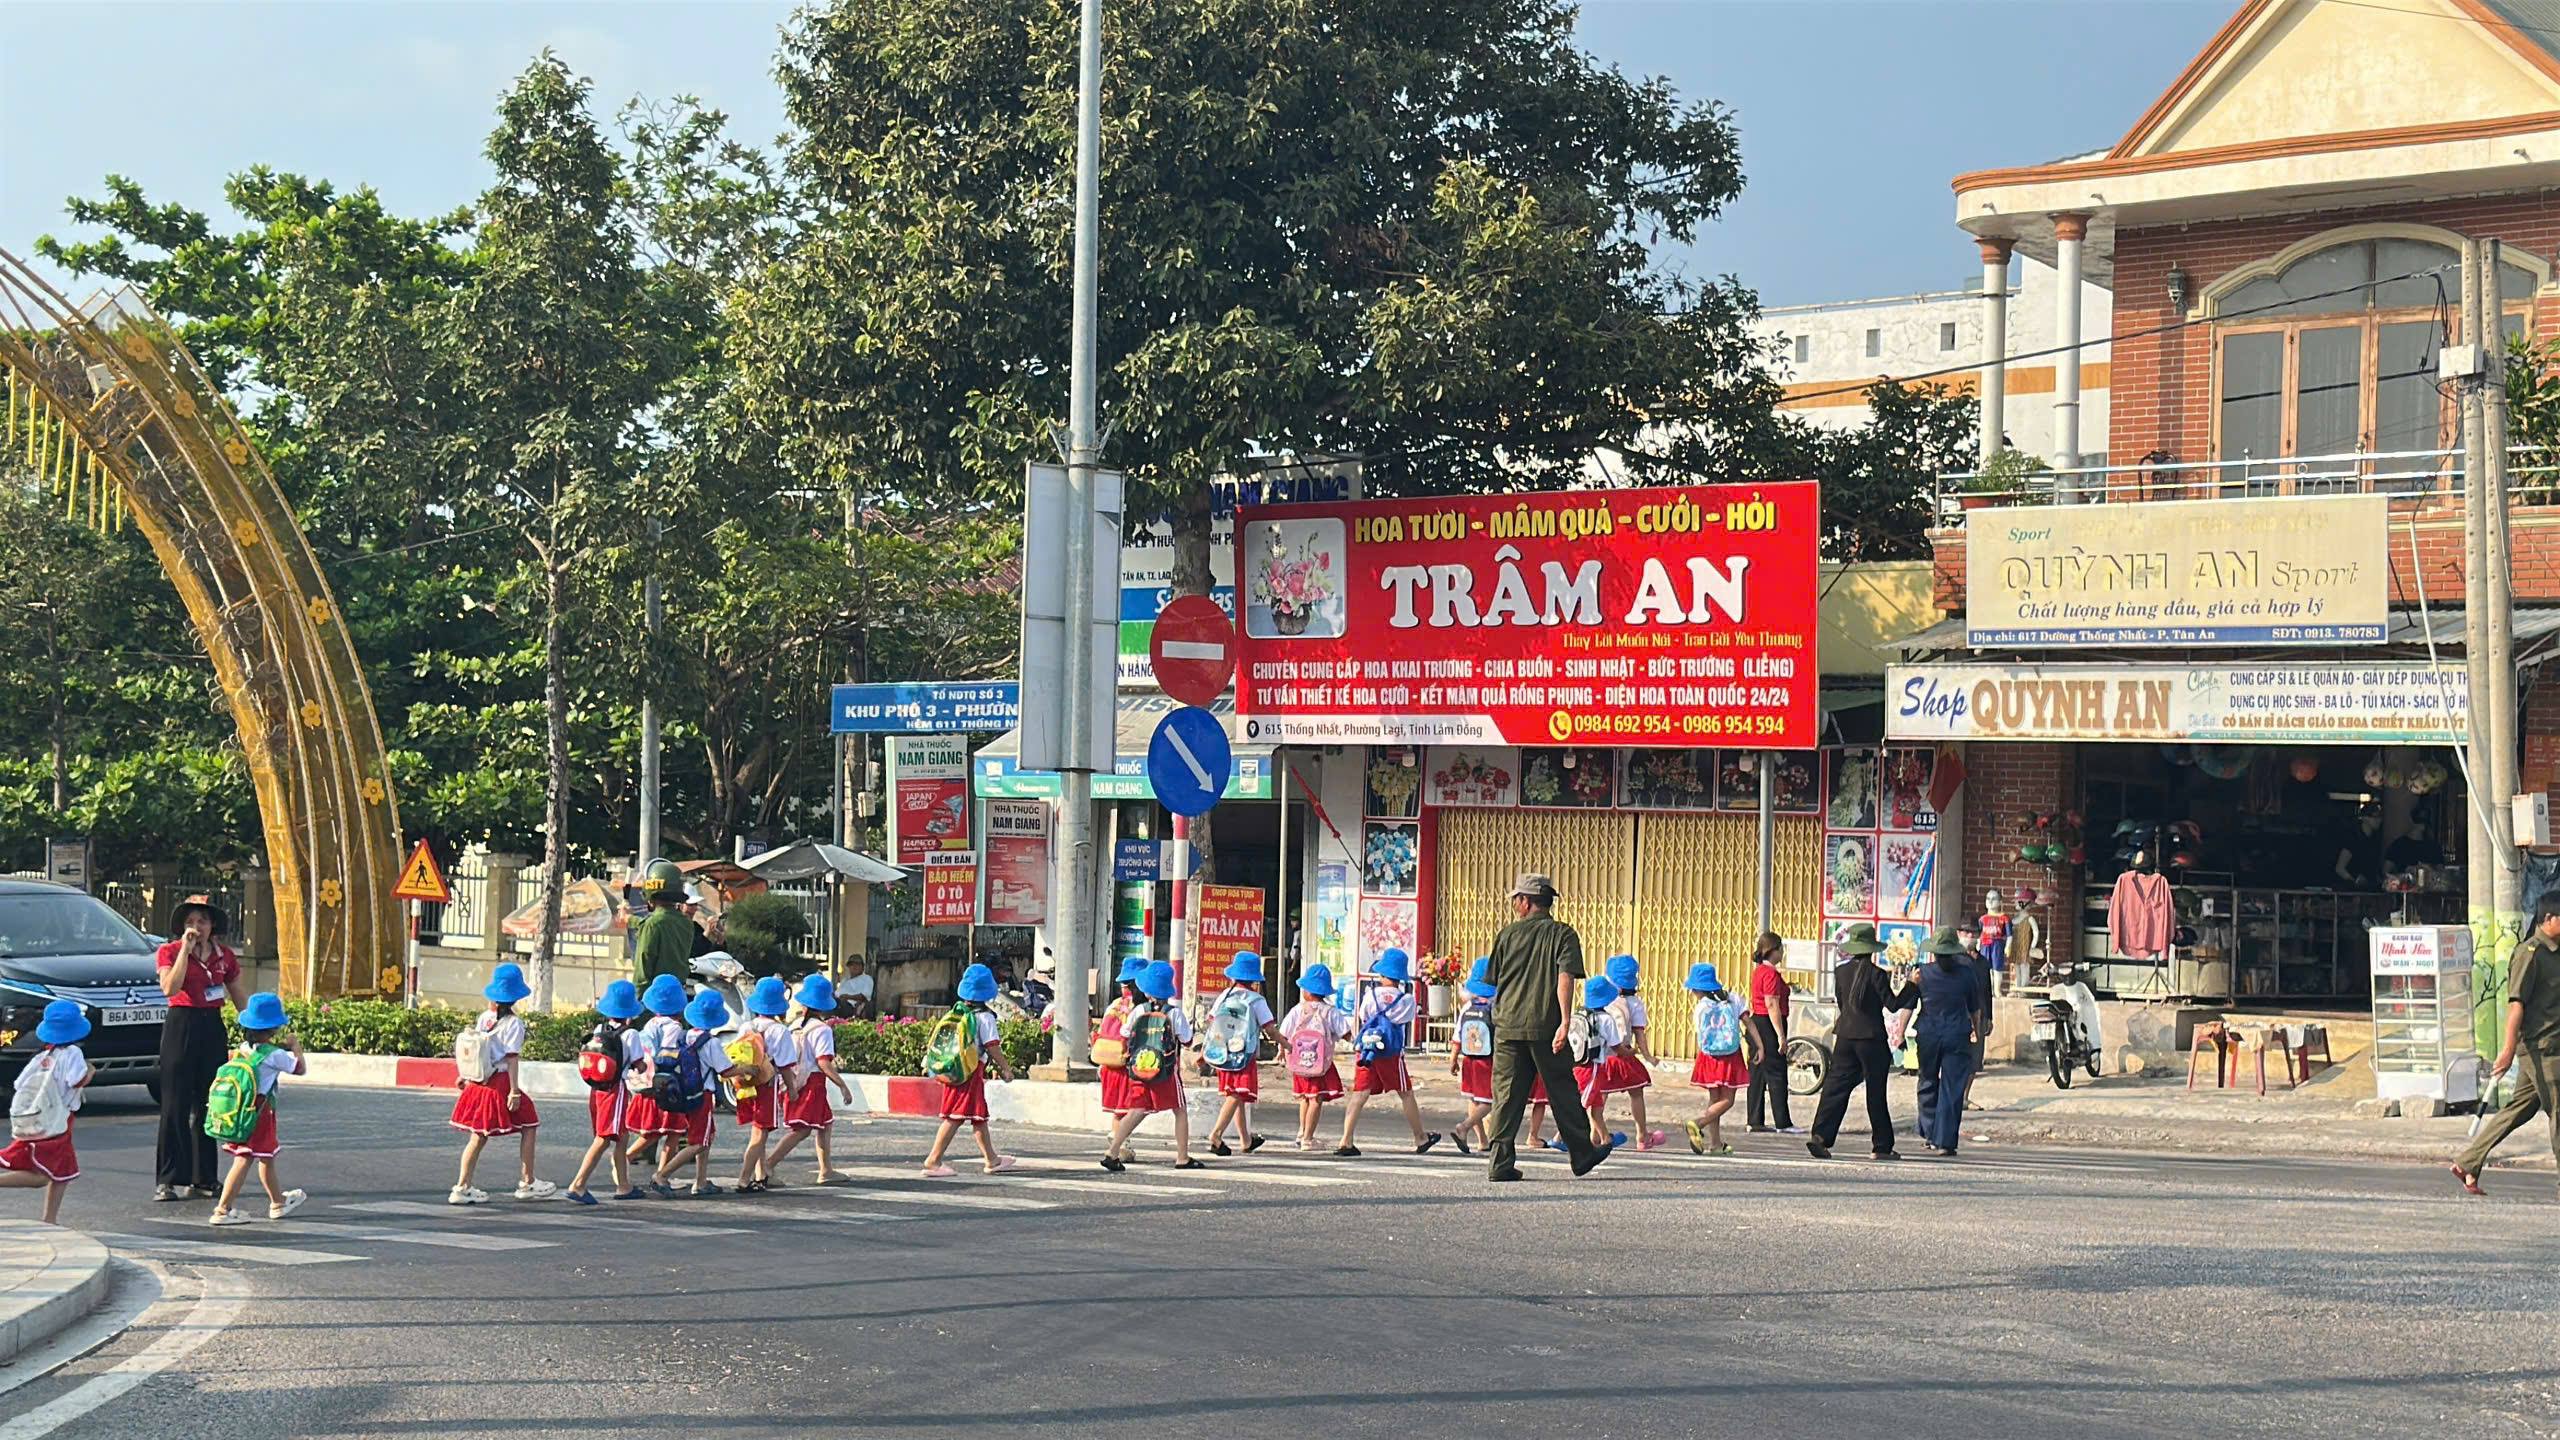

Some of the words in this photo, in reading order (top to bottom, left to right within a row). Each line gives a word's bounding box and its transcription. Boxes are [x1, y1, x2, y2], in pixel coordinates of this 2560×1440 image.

[1354, 516, 1403, 543] HOA
[1408, 508, 1465, 541] TƯƠI
[1489, 502, 1555, 538] MÂM
[1560, 498, 1612, 541] QUẢ
[1637, 493, 1700, 533] CƯỚI
[1726, 491, 1775, 531] HỎI
[2007, 527, 2051, 546] Sport
[2000, 545, 2169, 600] QUỲNH
[2190, 550, 2258, 591] AN
[2271, 560, 2360, 593] Sport
[1380, 543, 1603, 628] TRÂM
[1624, 556, 1750, 625] AN
[2018, 600, 2058, 619] Chất
[2063, 602, 2111, 623] lượng
[2115, 600, 2157, 618] hàng
[2206, 598, 2235, 618] giá
[2240, 599, 2261, 615] cả
[2268, 598, 2300, 617] hợp
[2307, 597, 2325, 617] lý
[1563, 632, 1591, 651] Thay
[1616, 631, 1649, 648] Muốn
[1652, 632, 1671, 648] Nói
[1735, 631, 1755, 647] Yêu
[2018, 631, 2037, 642] 617
[2079, 629, 2116, 643] Thống
[2172, 628, 2196, 641] Tân
[2198, 629, 2216, 641] An
[2339, 626, 2380, 638] 780783
[1252, 659, 1298, 680] CHUYÊN
[1300, 661, 1333, 680] CUNG
[1336, 656, 1361, 679] CẤP
[1364, 660, 1389, 679] HOA
[1391, 660, 1421, 679] KHAI
[1423, 659, 1473, 679] TRƯƠNG
[1484, 659, 1515, 679] CHIA
[1565, 658, 1598, 679] SINH
[1600, 655, 1636, 680] NHẬT
[1648, 654, 1676, 679] BỨC
[1679, 654, 1735, 679] TRƯỚNG
[2230, 671, 2255, 686] CUNG
[2288, 672, 2296, 685] &
[2411, 671, 2438, 689] DỤNG
[979, 687, 994, 700] SỐ
[996, 690, 1004, 699] 3
[1257, 686, 1273, 706] TƯ
[1274, 682, 1297, 706] VẤN
[1300, 682, 1333, 706] THIẾT
[1335, 682, 1352, 706] KẾ
[1353, 687, 1377, 706] HOA
[1380, 683, 1409, 706] CƯỚI
[1420, 682, 1444, 706] KẾT
[1446, 685, 1478, 706] MÂM
[1481, 681, 1507, 707] QUẢ
[1550, 686, 1593, 710] PHỤNG
[1604, 684, 1636, 709] ĐIỆN
[1639, 686, 1666, 706] HOA
[1669, 684, 1705, 706] TOÀN
[1708, 681, 1747, 708] QUỐC
[1750, 686, 1790, 707] 24/24
[2230, 694, 2255, 712] DỤNG
[2257, 694, 2270, 712] CỤ
[2273, 694, 2292, 712] HỌC
[2294, 695, 2316, 709] SINH
[2324, 695, 2337, 709] BA
[2362, 691, 2378, 709] TÚI
[2380, 691, 2405, 709] XÁCH
[2414, 692, 2439, 709] SÁCH
[844, 704, 881, 719] KHU
[884, 701, 922, 719] PHỐ
[925, 704, 937, 718] 3
[954, 700, 1018, 718] PHƯỜN
[1899, 676, 1969, 729] Shop
[2113, 680, 2172, 729] AN
[935, 719, 957, 729] 611
[960, 717, 1002, 729] THỐNG
[1574, 714, 1611, 734] 0984
[1614, 714, 1641, 734] 692
[1644, 714, 1671, 734] 954
[1683, 714, 1722, 735] 0986
[1725, 714, 1753, 735] 954
[1756, 714, 1785, 735] 594
[2222, 713, 2237, 728] CÓ
[2239, 713, 2262, 728] BÁN
[2277, 713, 2306, 728] SÁCH
[2308, 713, 2335, 729] GIÁO
[2337, 716, 2369, 729] KHOA
[2371, 712, 2405, 729] CHIẾT
[2407, 712, 2441, 729] KHẤU
[1265, 723, 1282, 736] 615
[1285, 721, 1314, 738] Thống
[1317, 721, 1342, 737] Nhất,
[1344, 722, 1381, 738] Phường
[1383, 722, 1407, 738] Lagi,
[1409, 721, 1431, 736] Tỉnh
[1433, 722, 1454, 736] Lâm
[908, 740, 925, 749] NHÀ
[926, 737, 952, 749] THUỐC
[898, 751, 925, 766] NAM
[928, 750, 963, 765] GIANG
[1093, 781, 1113, 795] NAM
[1115, 782, 1143, 795] GIANG
[994, 804, 1012, 814] NHÀ
[1012, 803, 1040, 815] THUỐC
[992, 816, 1013, 829] NAM
[1014, 817, 1041, 831] GIANG
[1914, 813, 1936, 825] 615
[954, 853, 971, 864] BÁN
[928, 867, 948, 884] BẢO
[937, 884, 946, 900] Ô
[948, 884, 964, 900] TÔ
[928, 903, 943, 916] XE
[946, 900, 972, 916] MÁY
[1201, 913, 1239, 937] TRÂM
[1241, 919, 1261, 938] AN
